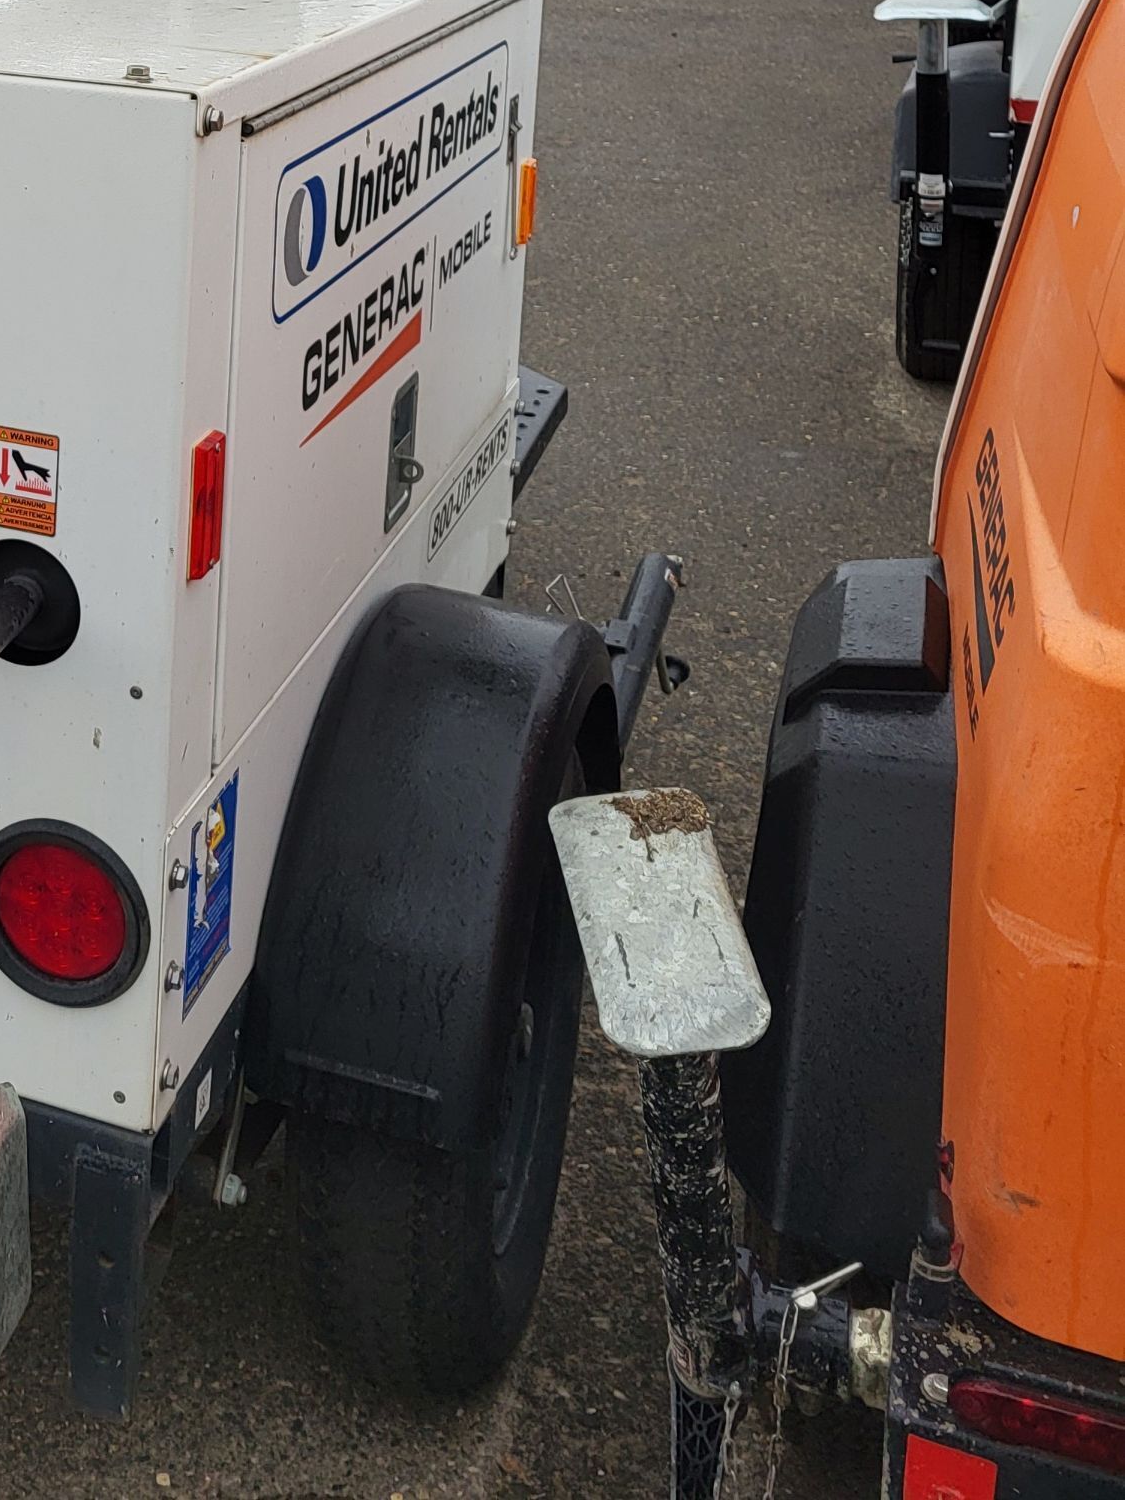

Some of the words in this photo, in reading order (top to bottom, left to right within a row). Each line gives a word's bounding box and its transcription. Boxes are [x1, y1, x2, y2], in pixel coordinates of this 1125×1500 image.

[334, 114, 425, 247] United
[426, 70, 498, 180] Rentals
[302, 247, 425, 411] GENERAC
[439, 210, 492, 289] MOBILE
[10, 431, 54, 447] WARNING
[5, 507, 52, 521] ADVERTENCIA
[10, 497, 46, 510] WARNUNG
[431, 419, 508, 549] 800-UR-RENTS
[3, 517, 53, 532] AVERTISSEMENT
[975, 427, 1016, 649] GENERAC
